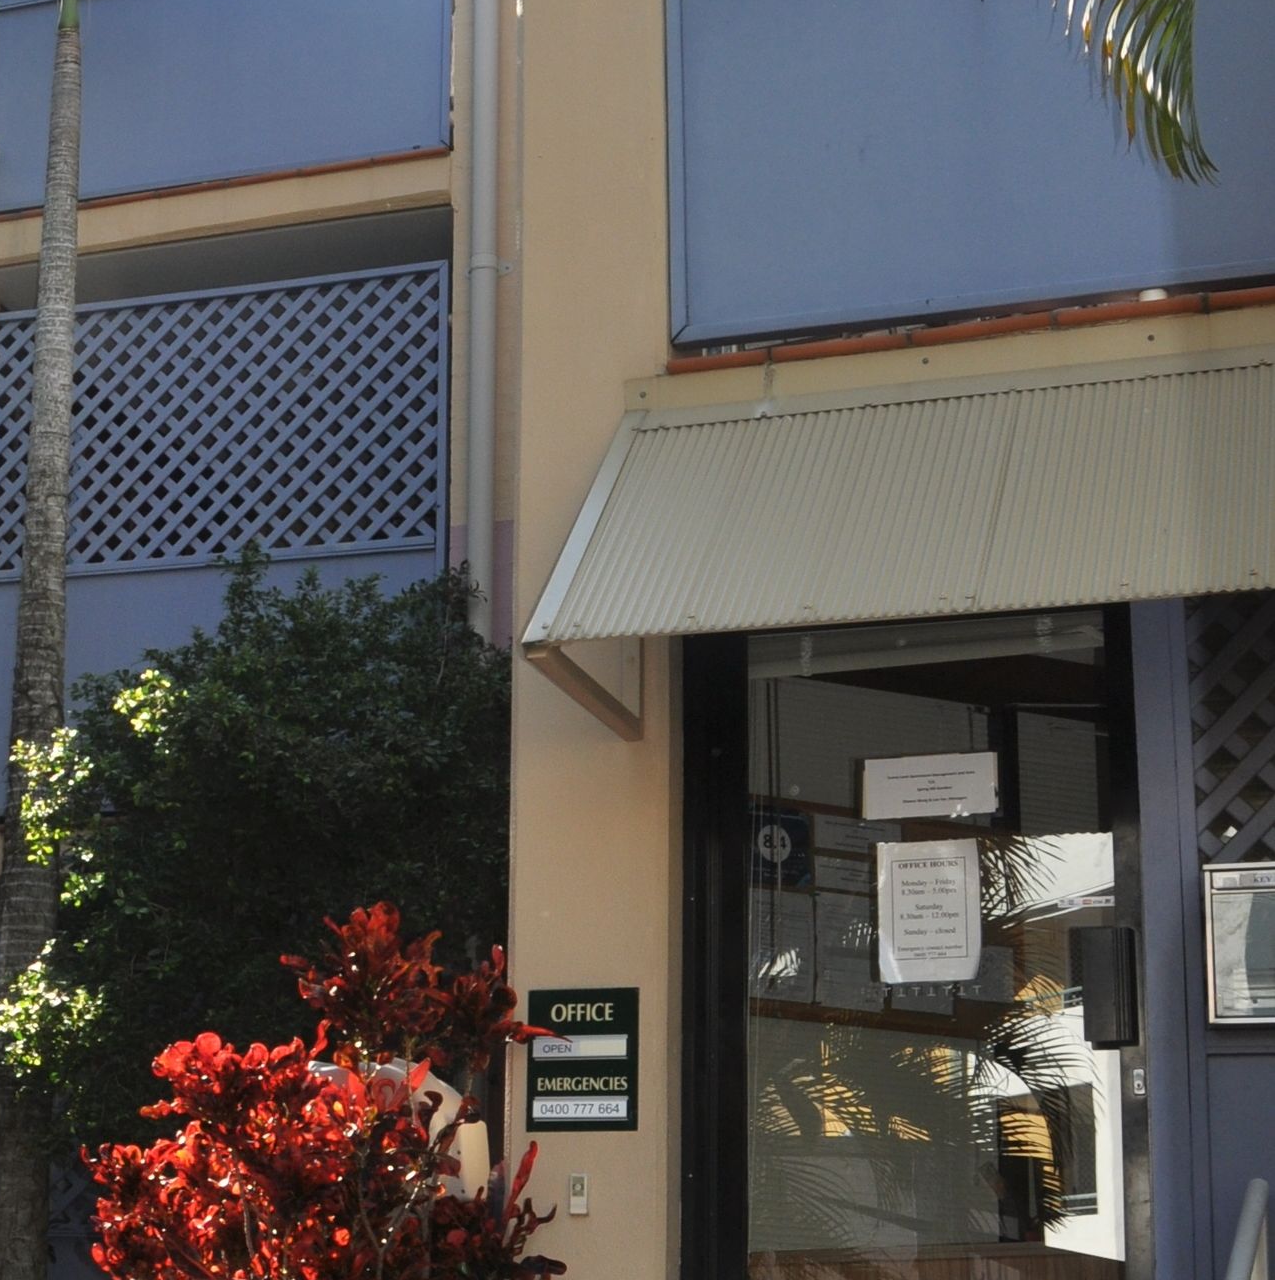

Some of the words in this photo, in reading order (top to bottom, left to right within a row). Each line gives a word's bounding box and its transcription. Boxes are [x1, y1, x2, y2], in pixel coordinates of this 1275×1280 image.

[898, 861, 926, 869] OFFICE
[930, 860, 958, 868] HOURS
[935, 878, 956, 886] Friday
[915, 903, 943, 911] Saturday
[931, 911, 959, 919] 12.00pm
[550, 1003, 614, 1022] OFFICE
[542, 1044, 572, 1053] OPEN
[537, 1076, 628, 1091] EMERGENCIES
[540, 1103, 569, 1114] 0400
[573, 1103, 594, 1114] 777
[598, 1103, 619, 1114] 664
